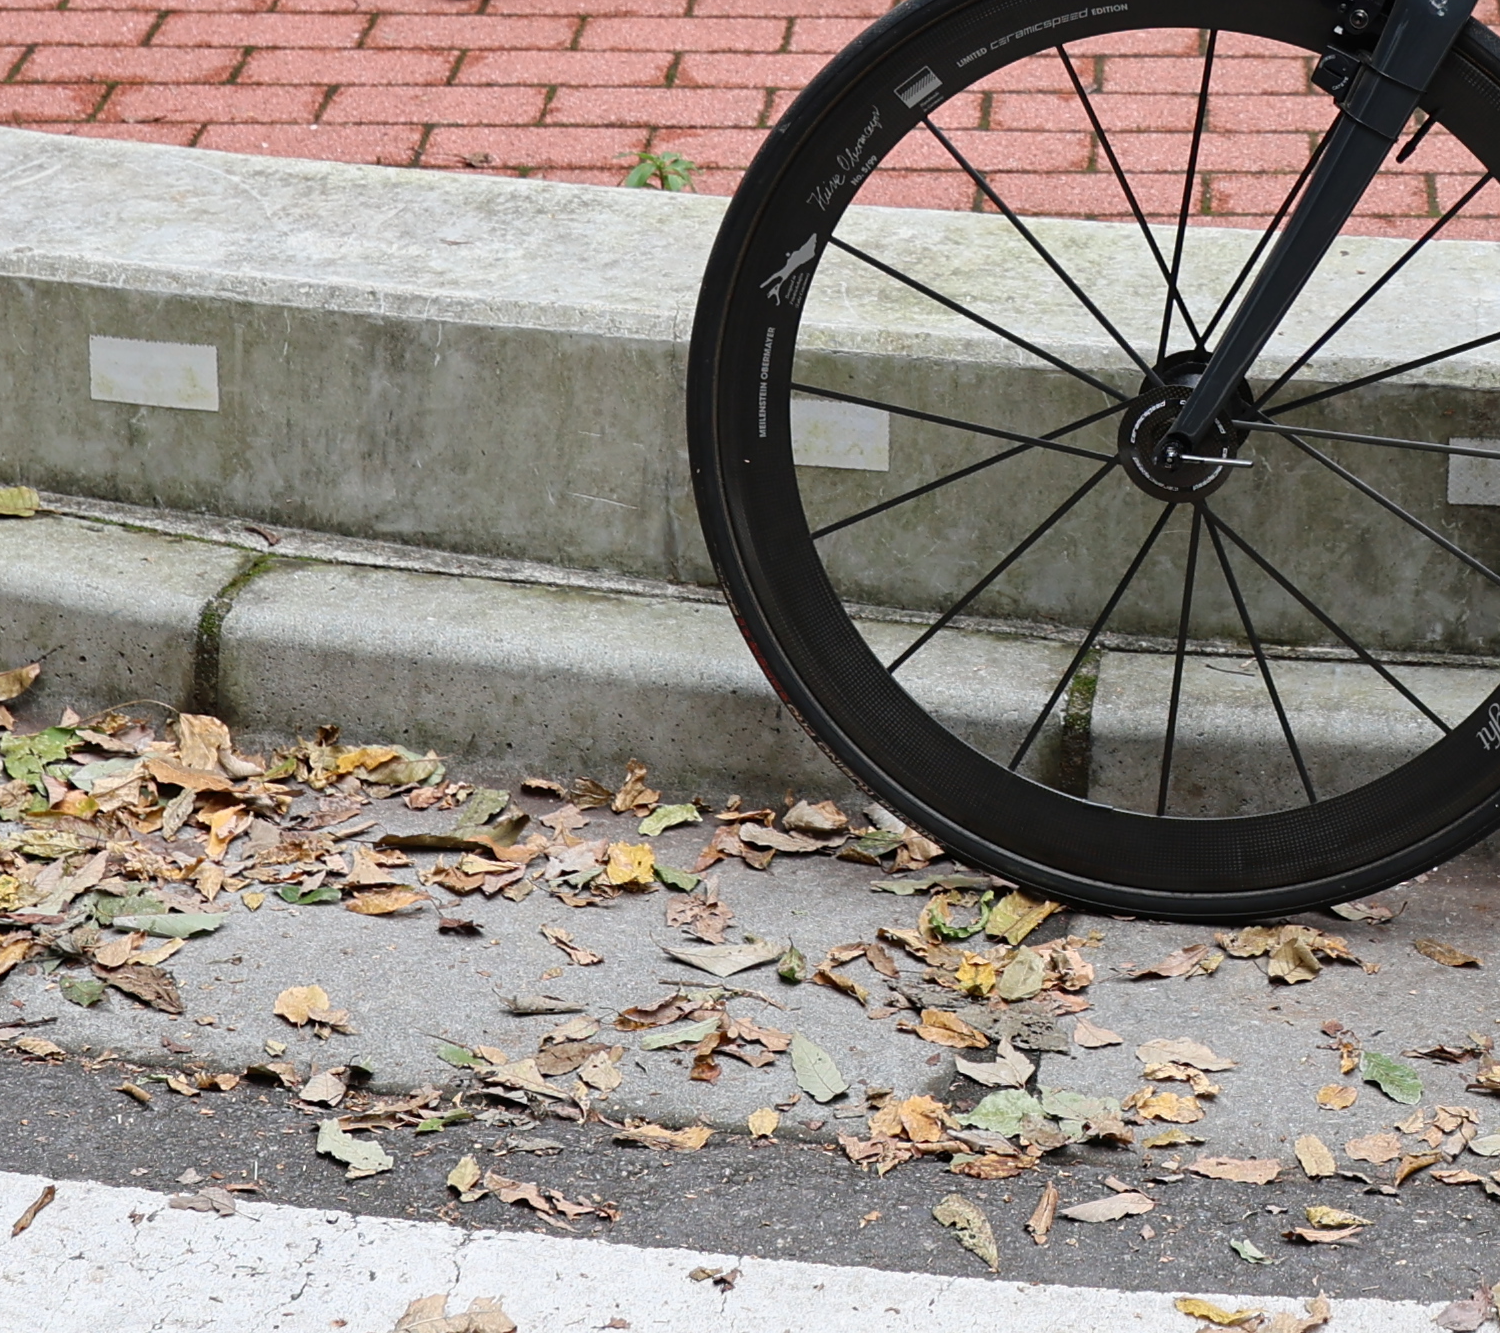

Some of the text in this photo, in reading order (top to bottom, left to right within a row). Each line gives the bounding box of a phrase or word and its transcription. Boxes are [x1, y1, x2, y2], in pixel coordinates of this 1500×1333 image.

[956, 2, 1129, 69] LIMITED ceramicspeed EDITION
[757, 326, 777, 439] MEILENSTEIN OBERMAYER
